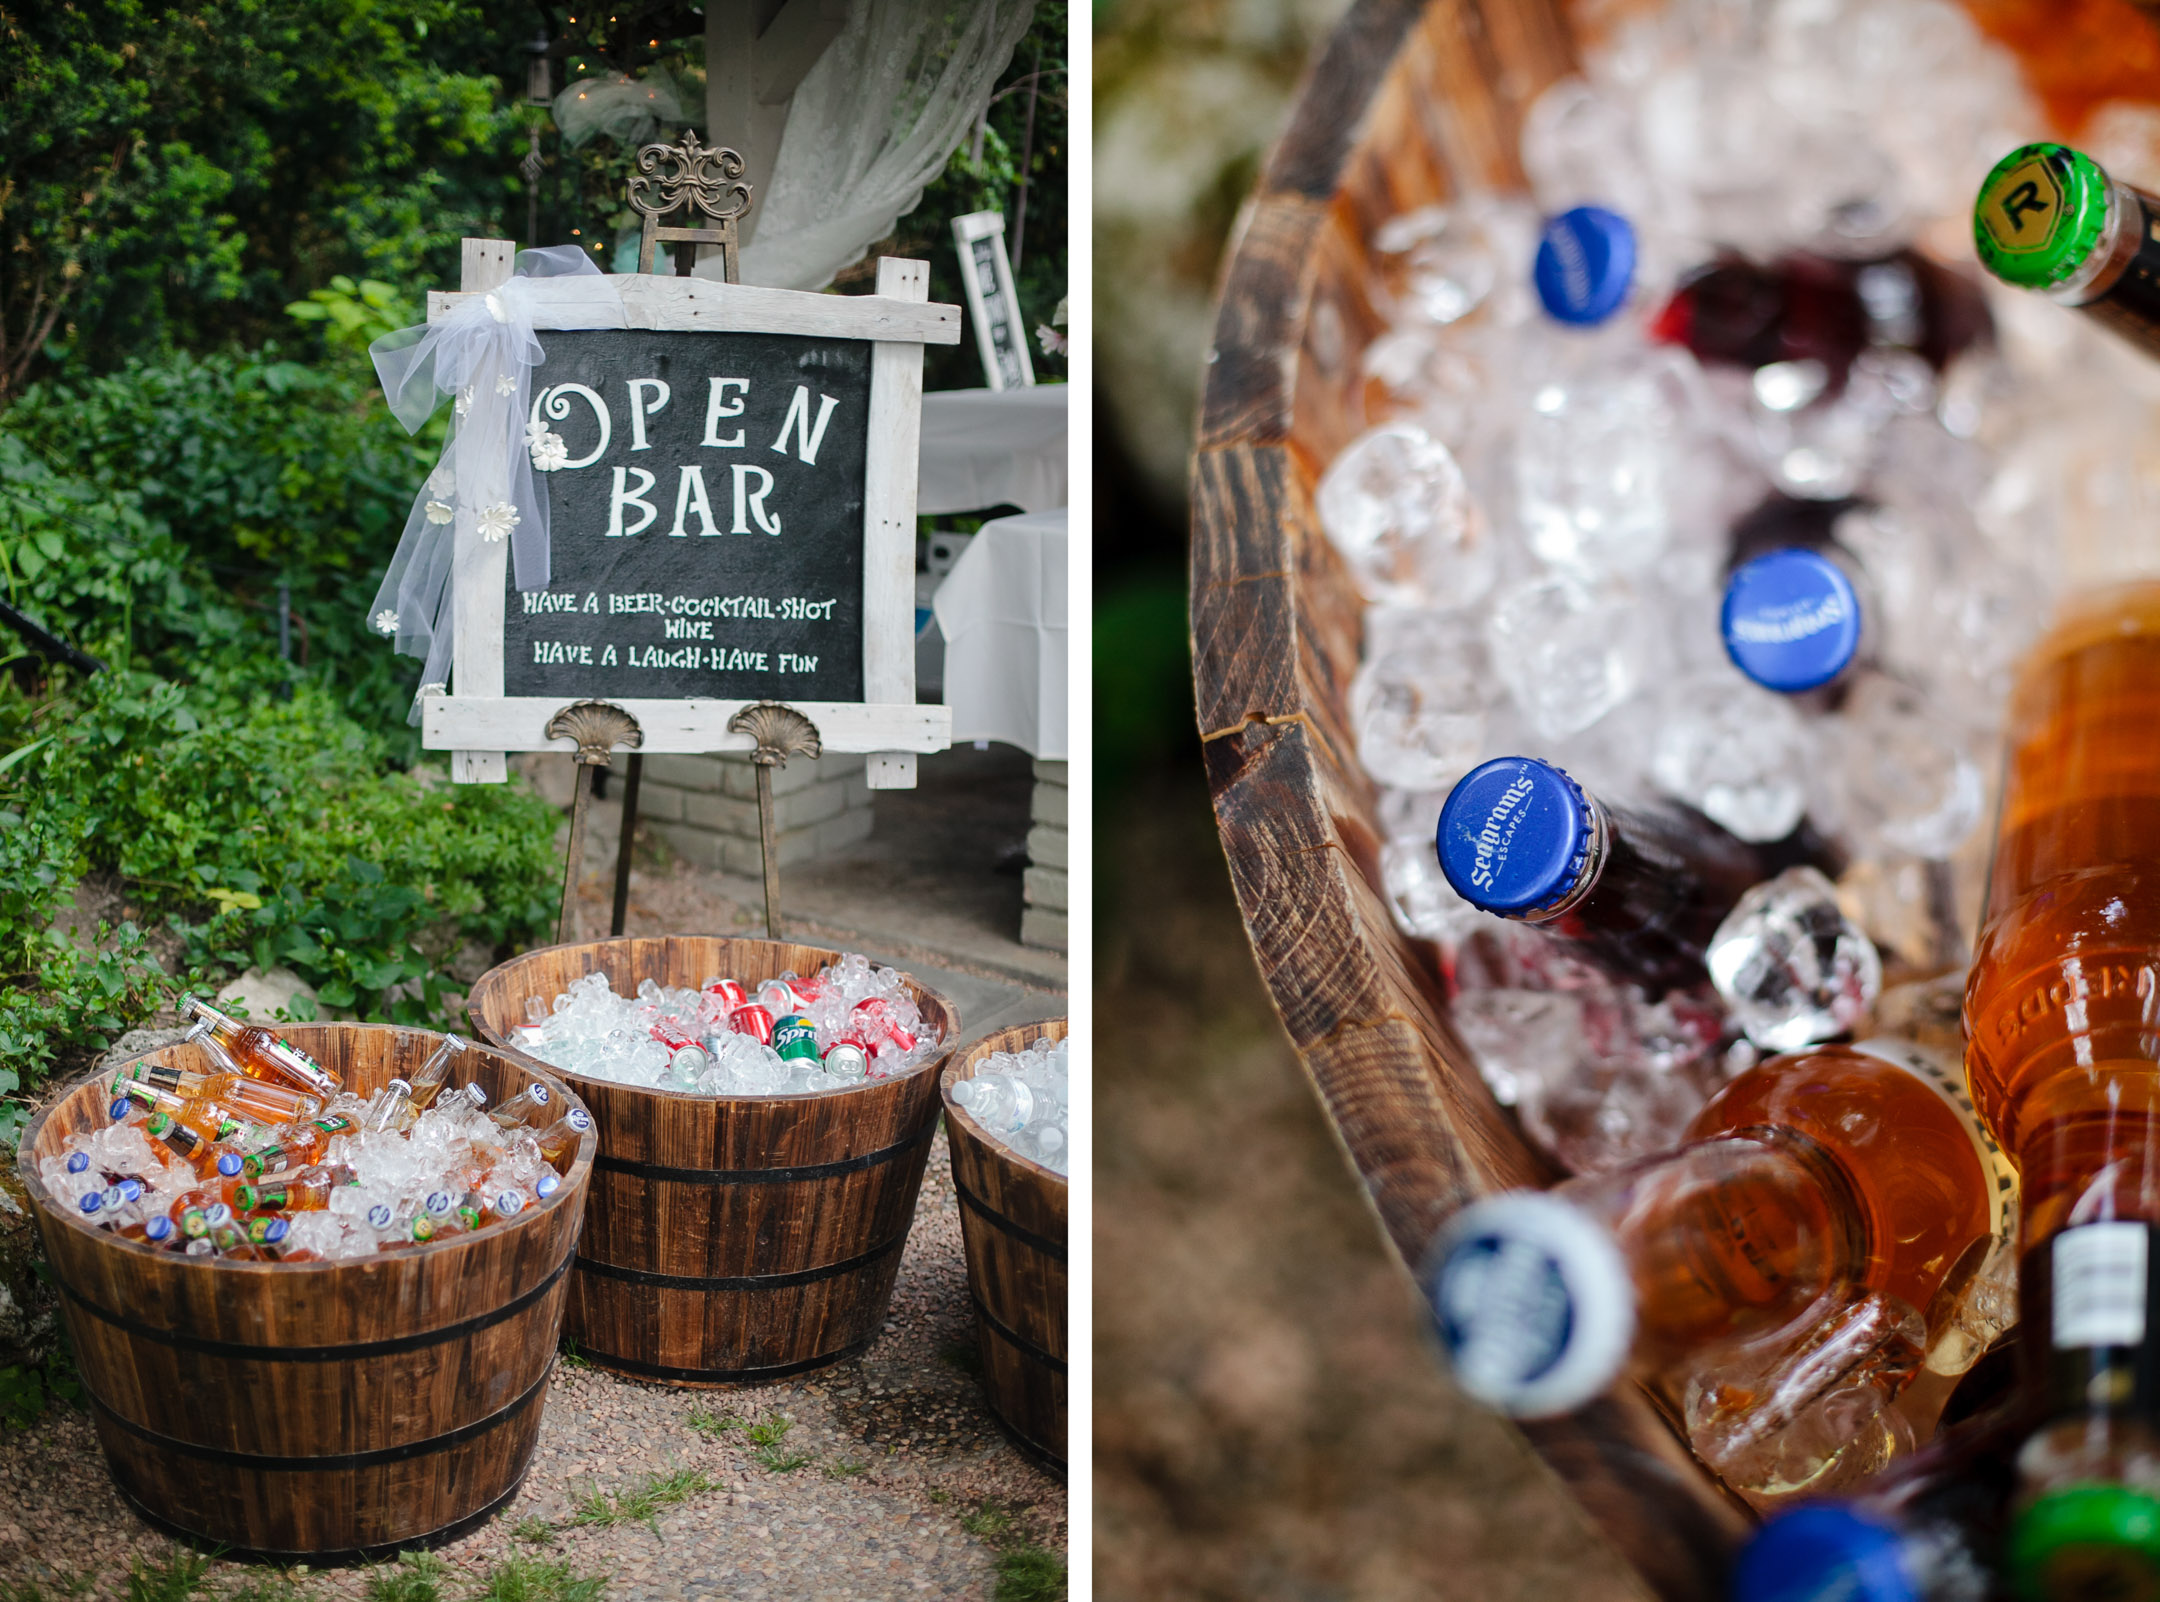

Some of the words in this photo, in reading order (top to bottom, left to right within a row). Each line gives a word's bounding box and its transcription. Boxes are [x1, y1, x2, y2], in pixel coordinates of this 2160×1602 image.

[2001, 181, 2049, 232] R
[530, 377, 840, 469] OPEN
[605, 464, 782, 537] BAR
[523, 592, 579, 614] HAVE
[583, 592, 600, 614] A
[664, 618, 714, 640] WINE
[533, 641, 593, 665] HAVE
[601, 644, 618, 666] A
[778, 653, 819, 674] FUN
[1498, 810, 1527, 861] ESCAPES
